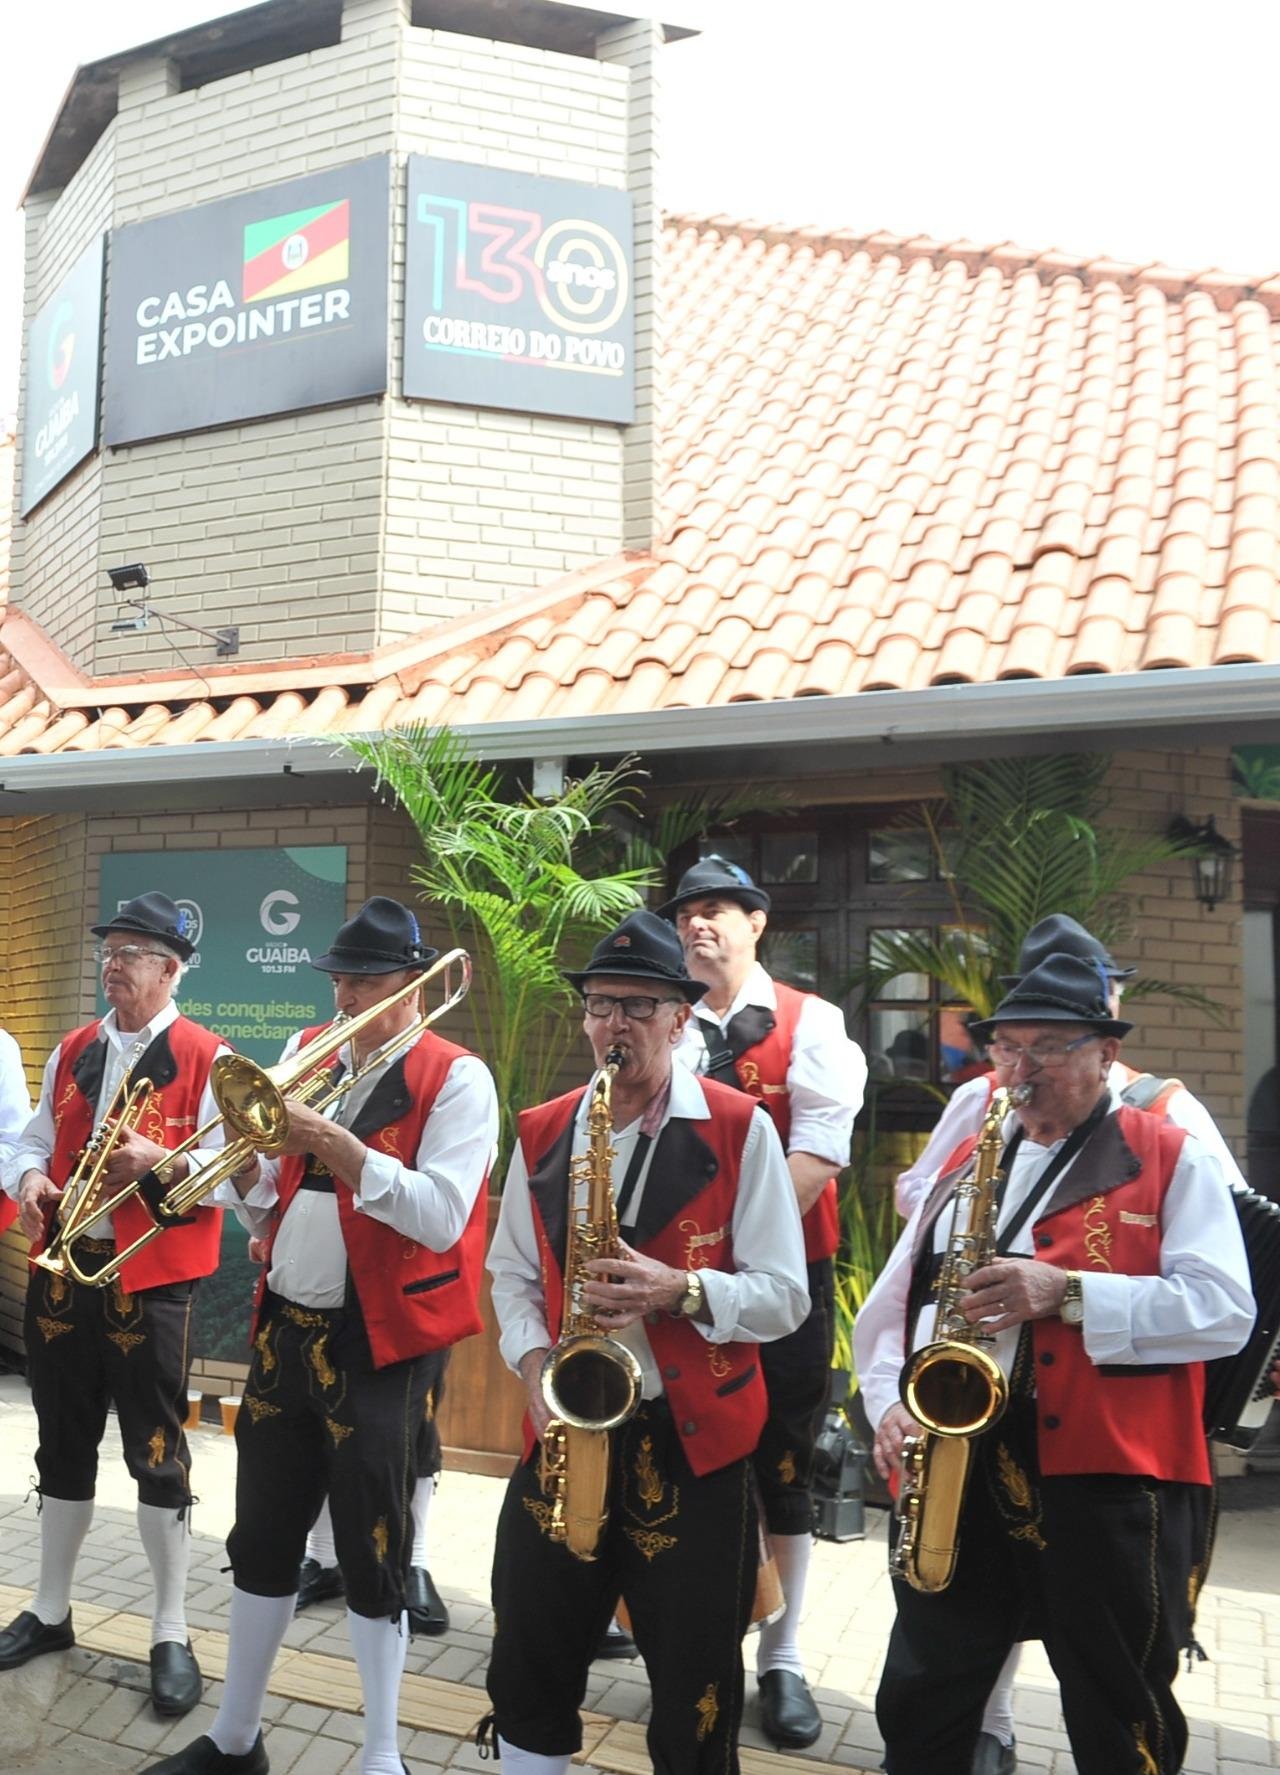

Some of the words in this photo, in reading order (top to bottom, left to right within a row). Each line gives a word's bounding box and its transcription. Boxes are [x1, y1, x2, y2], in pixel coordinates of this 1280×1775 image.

[417, 193, 629, 334] 130
[135, 280, 236, 330] CASA
[135, 288, 351, 367] EXPOINTER
[423, 316, 526, 355] CORREIO
[529, 330, 561, 361] DO
[564, 335, 625, 369] POVO
[217, 1000, 317, 1022] conquistas
